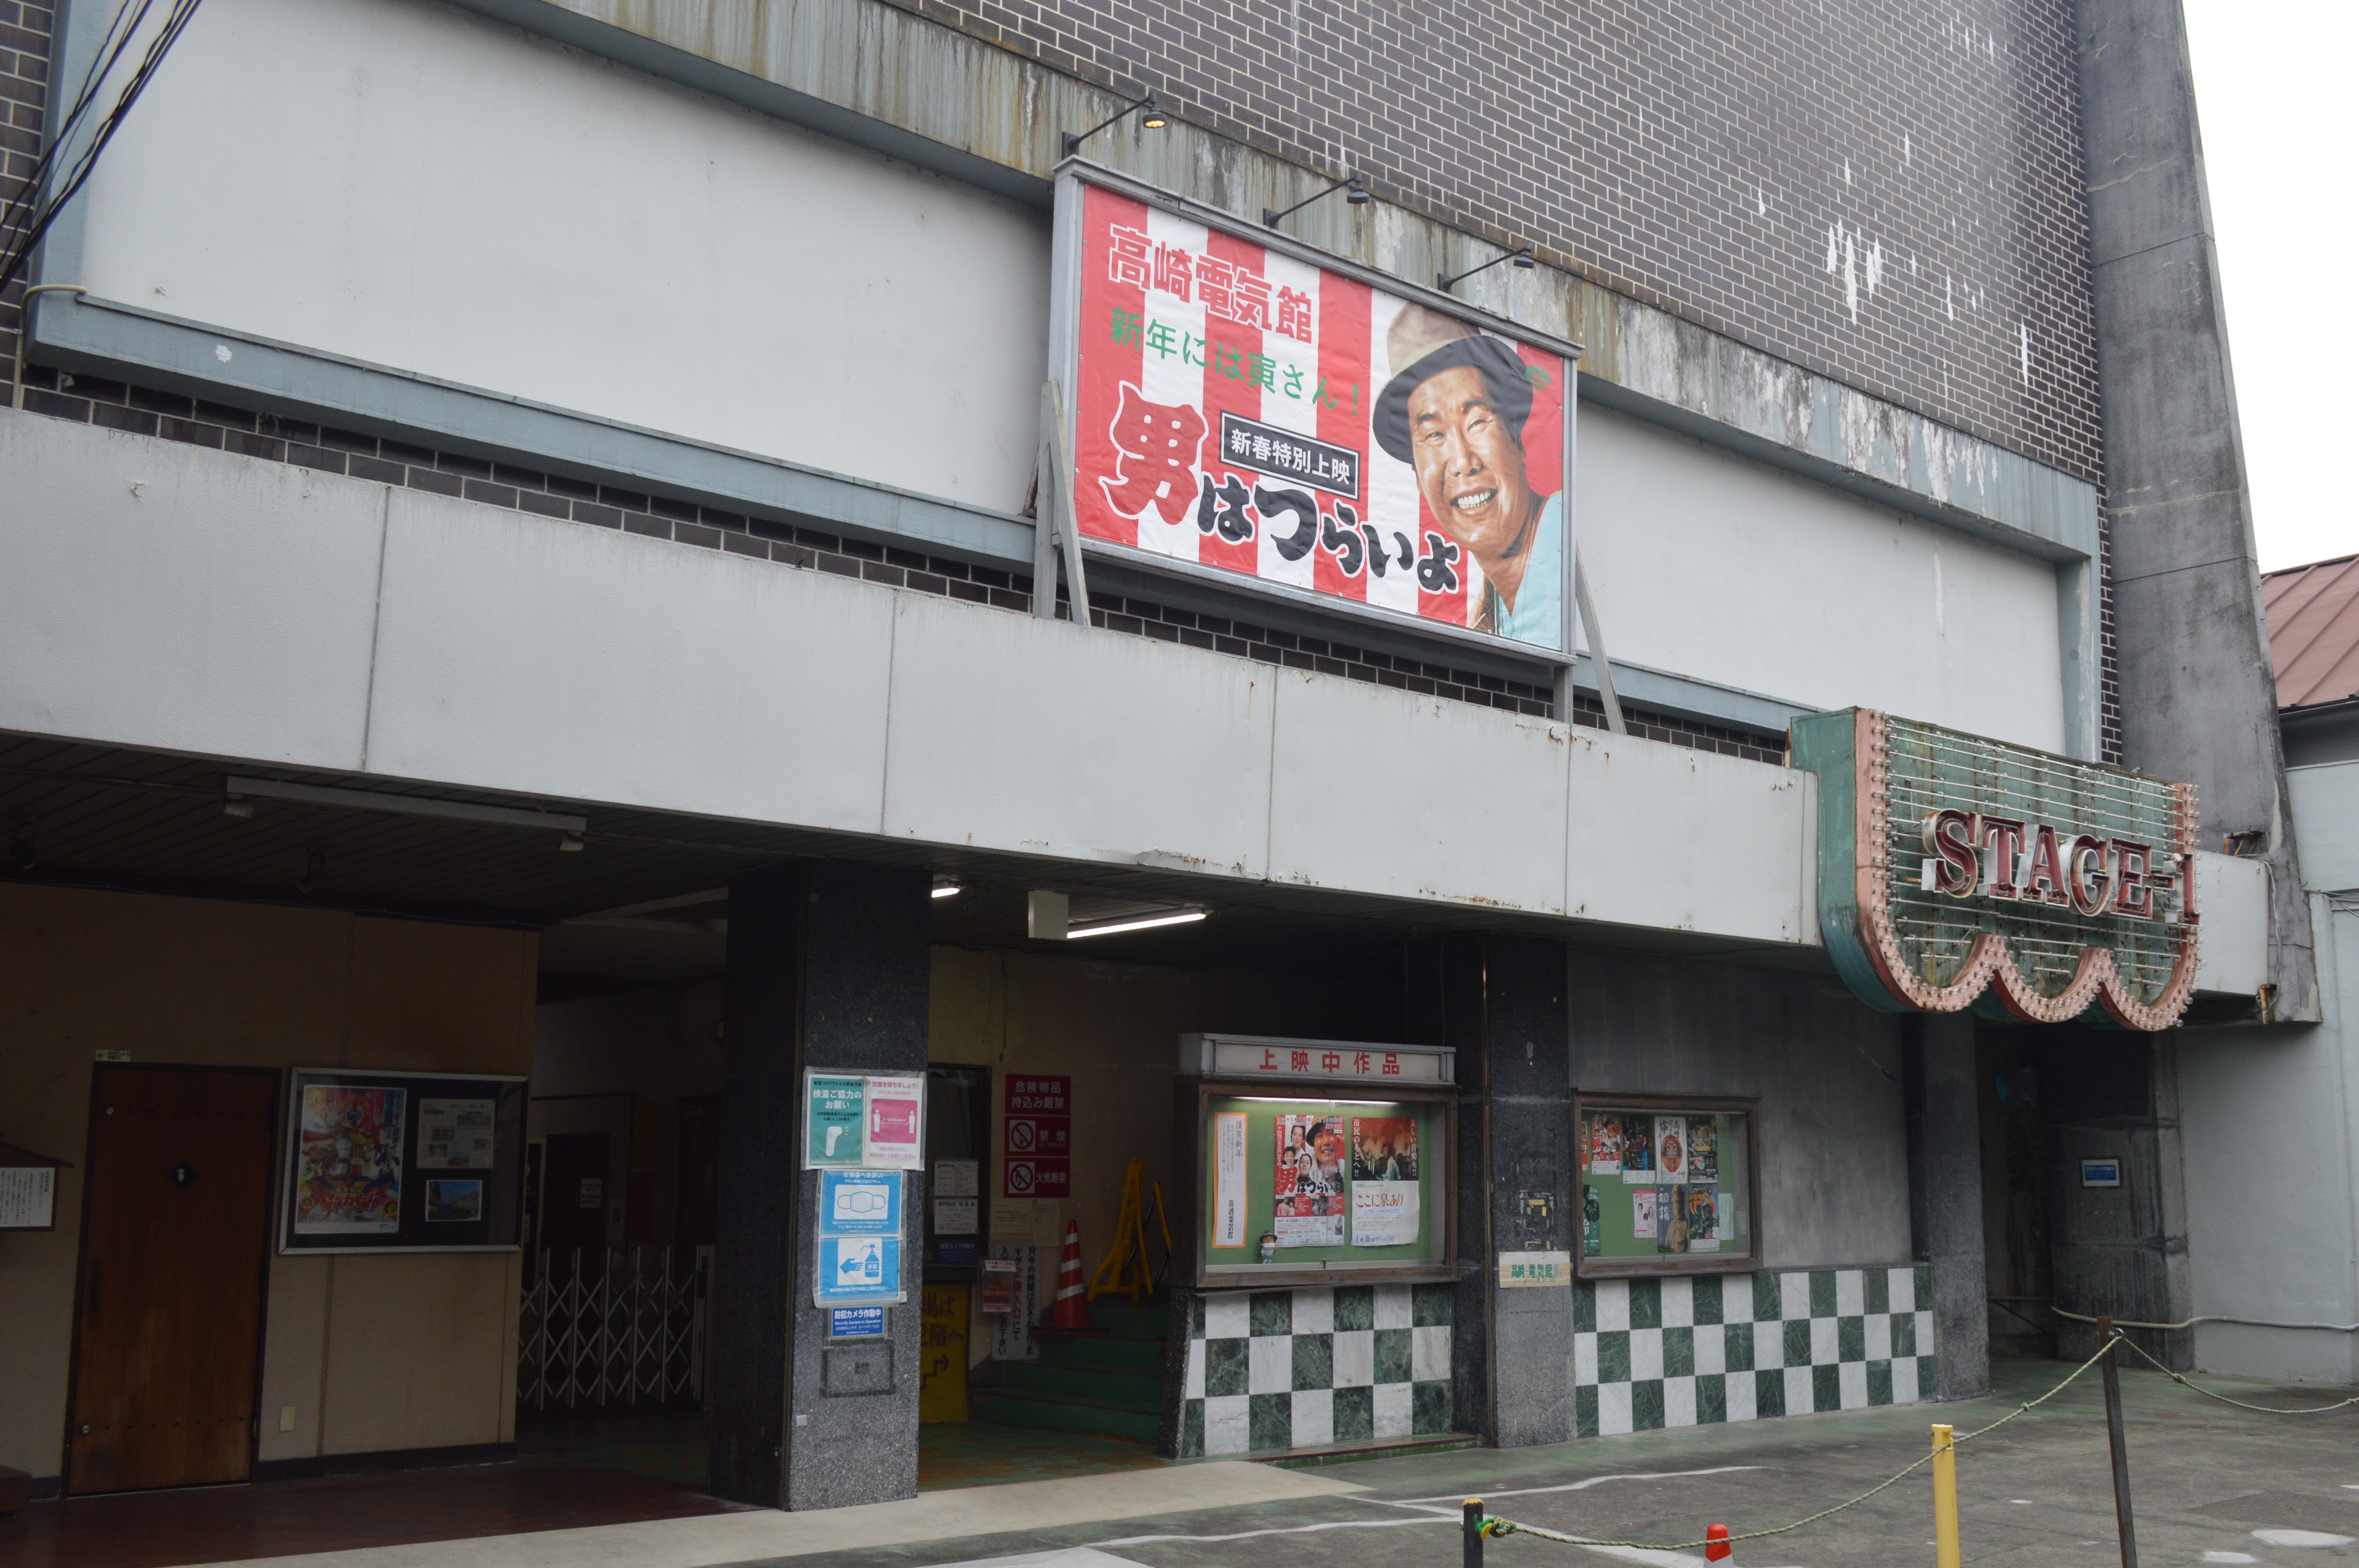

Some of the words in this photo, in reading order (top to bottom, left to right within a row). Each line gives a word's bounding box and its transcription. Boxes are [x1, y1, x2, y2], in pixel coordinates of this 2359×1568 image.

[1108, 223, 1313, 344] 高崎電気館
[1230, 428, 1351, 488] 新春特別上映
[1099, 381, 1460, 594] 男はつらいよ
[1259, 1049, 1400, 1075] 上映中作品
[813, 1089, 861, 1099] 検温ご協力の
[1015, 1081, 1061, 1093] 危険物品
[826, 1101, 849, 1109] お願い
[1011, 1096, 1065, 1109] 持込み厳禁
[1036, 1172, 1067, 1183] 火気厳禁
[1277, 1166, 1341, 1194] 男はつらいよ
[1356, 1193, 1403, 1208] ここに泉あり
[1658, 1192, 1670, 1221] 初詣
[835, 1308, 881, 1320] 防犯カメラ作動中
